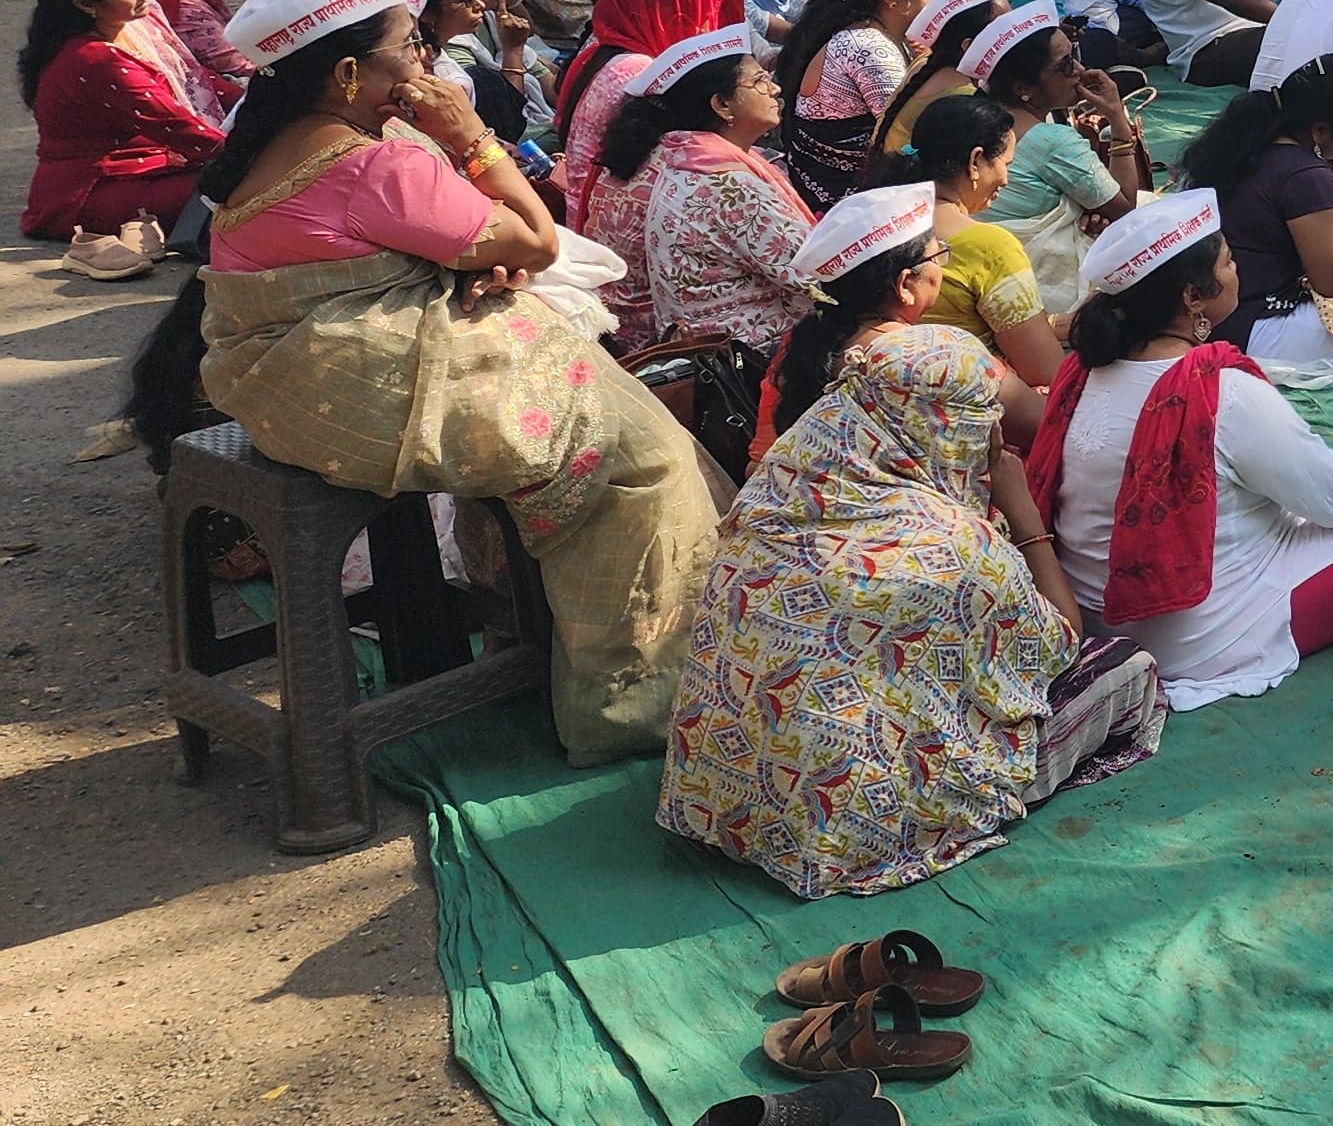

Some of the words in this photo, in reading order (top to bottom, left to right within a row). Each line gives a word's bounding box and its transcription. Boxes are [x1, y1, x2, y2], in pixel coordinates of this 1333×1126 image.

[256, 30, 297, 55] महाराष्ट्र
[292, 16, 316, 37] राज्य
[816, 255, 846, 277] महाराष्ट्र
[843, 241, 863, 260] राज्य
[860, 225, 894, 250] प्राथमिक
[1131, 248, 1150, 268] राज्य
[1149, 228, 1183, 257] प्राथमिक
